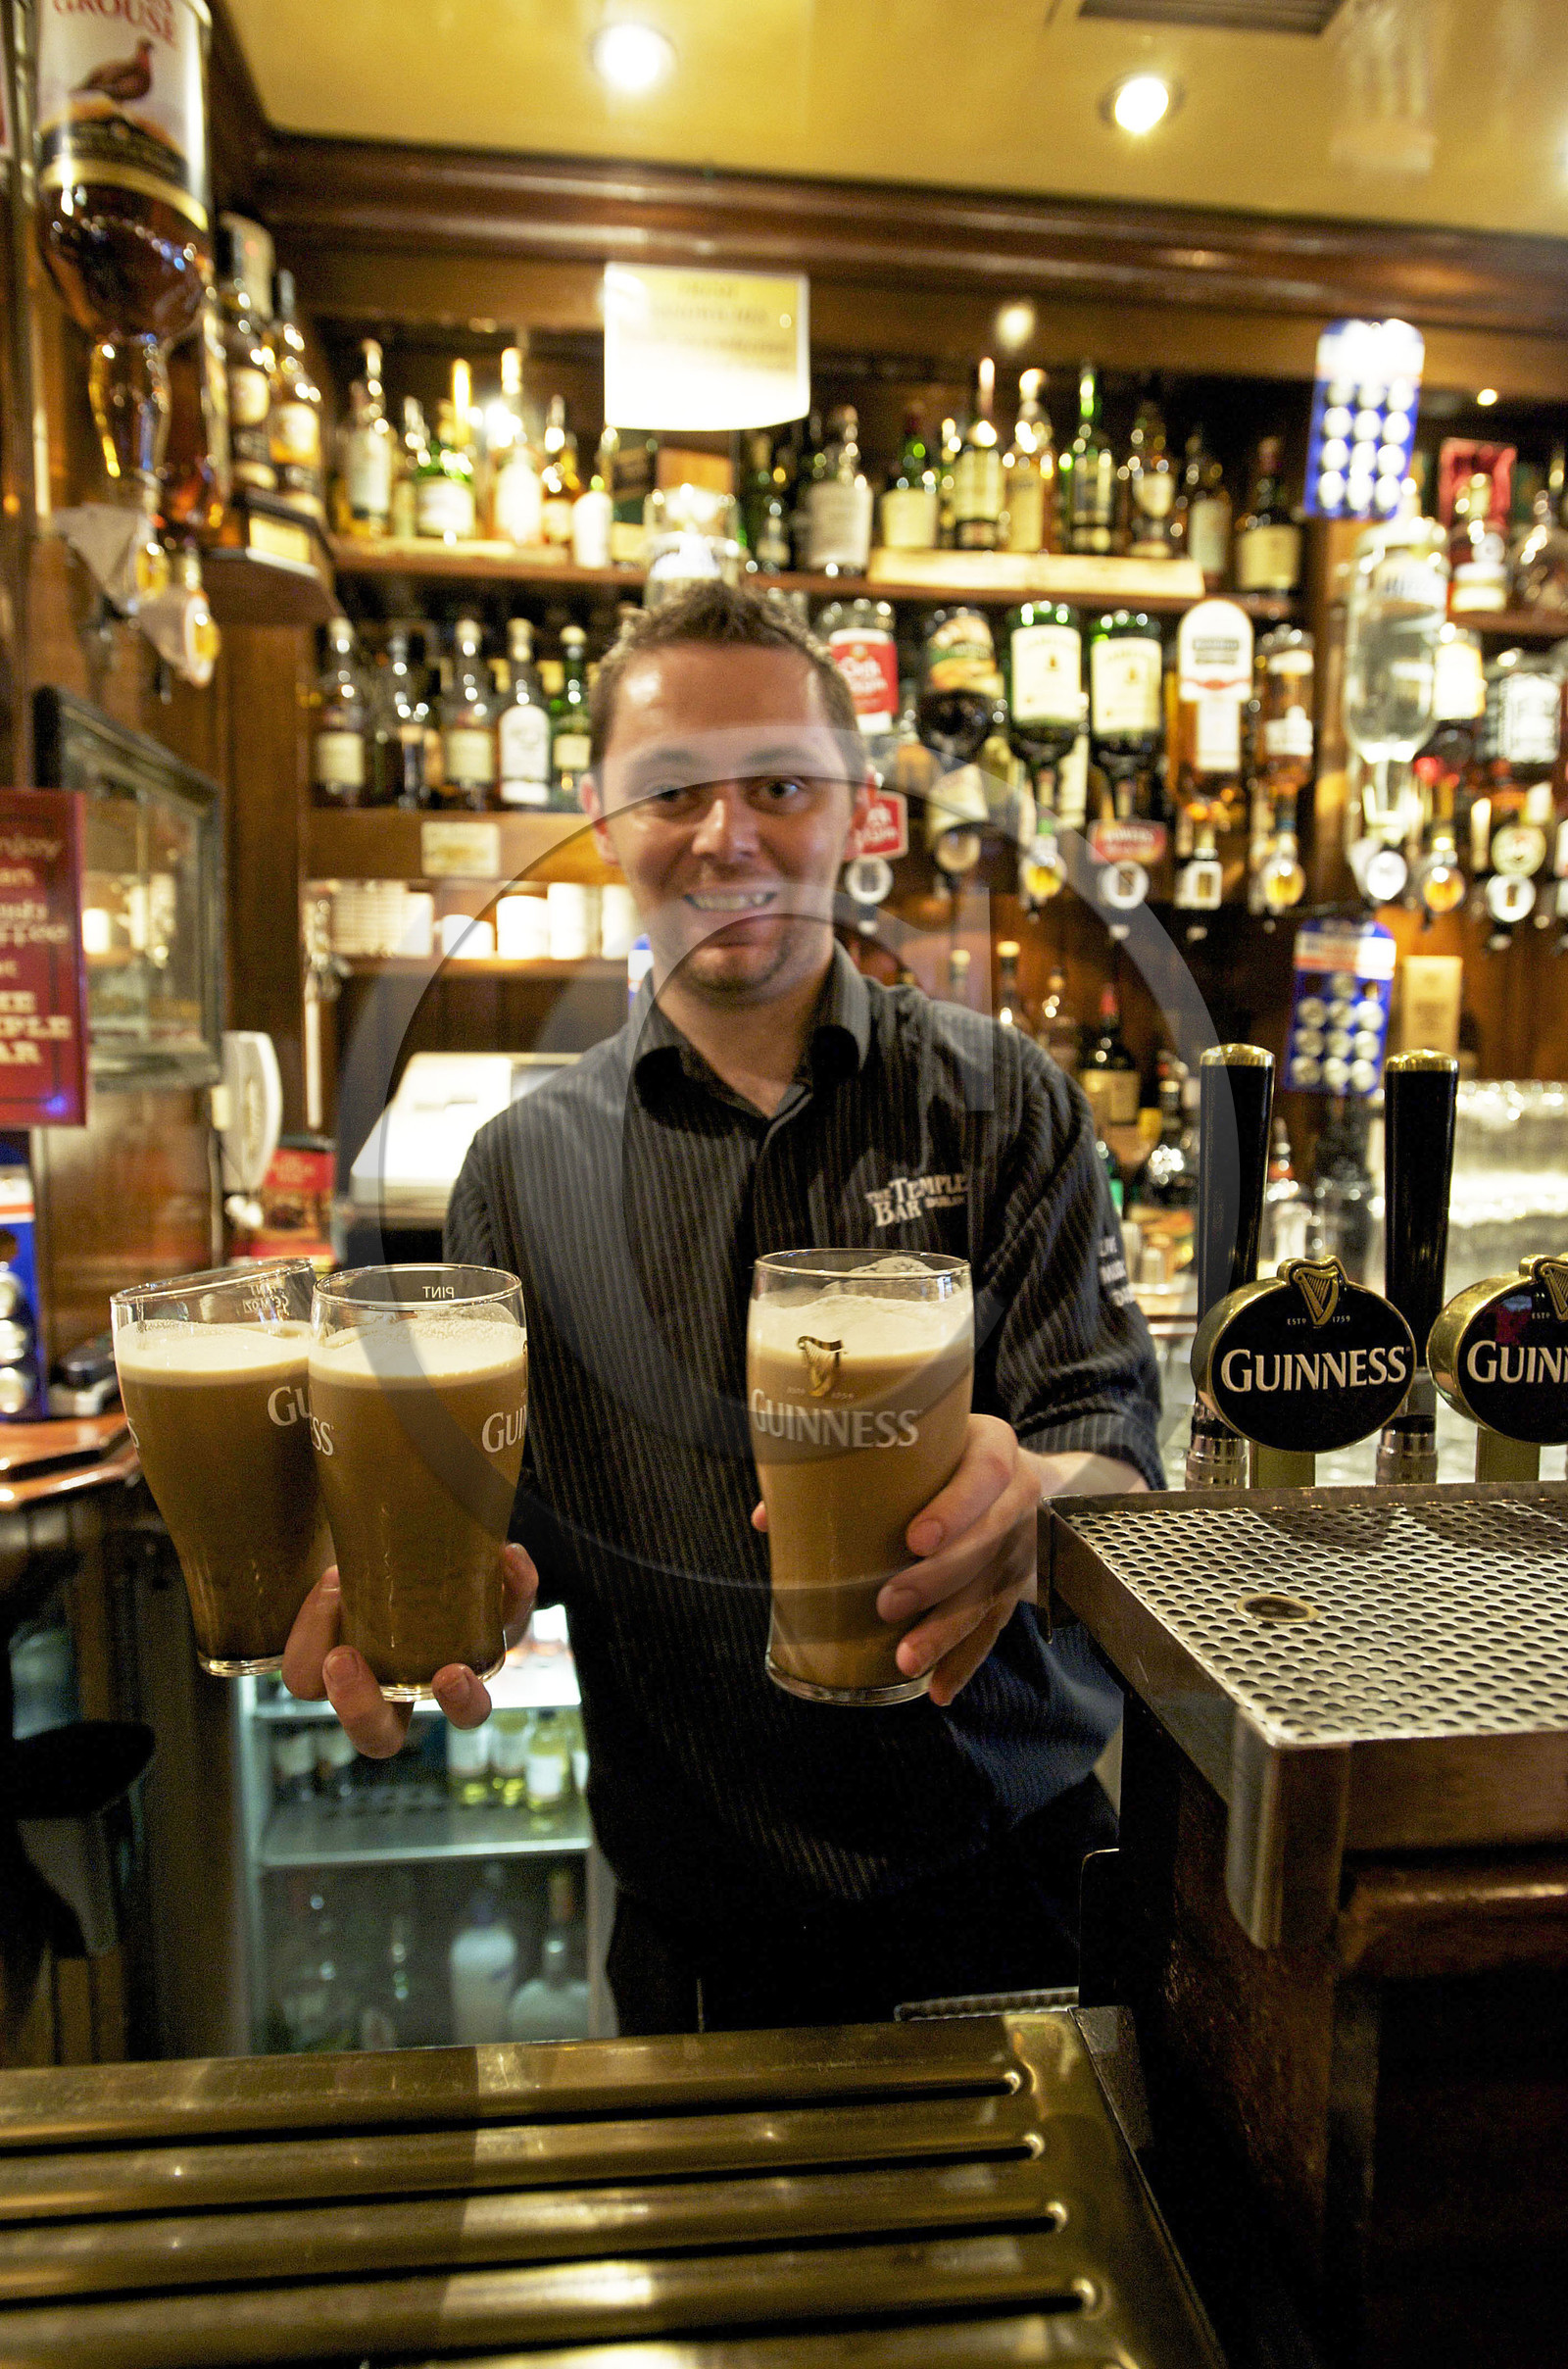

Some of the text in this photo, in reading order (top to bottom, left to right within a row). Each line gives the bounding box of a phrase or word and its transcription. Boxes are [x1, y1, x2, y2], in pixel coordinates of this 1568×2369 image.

[873, 1201, 922, 1227] BAR
[1221, 1346, 1407, 1393] GUINNESS
[751, 1388, 919, 1449] GUINNESS
